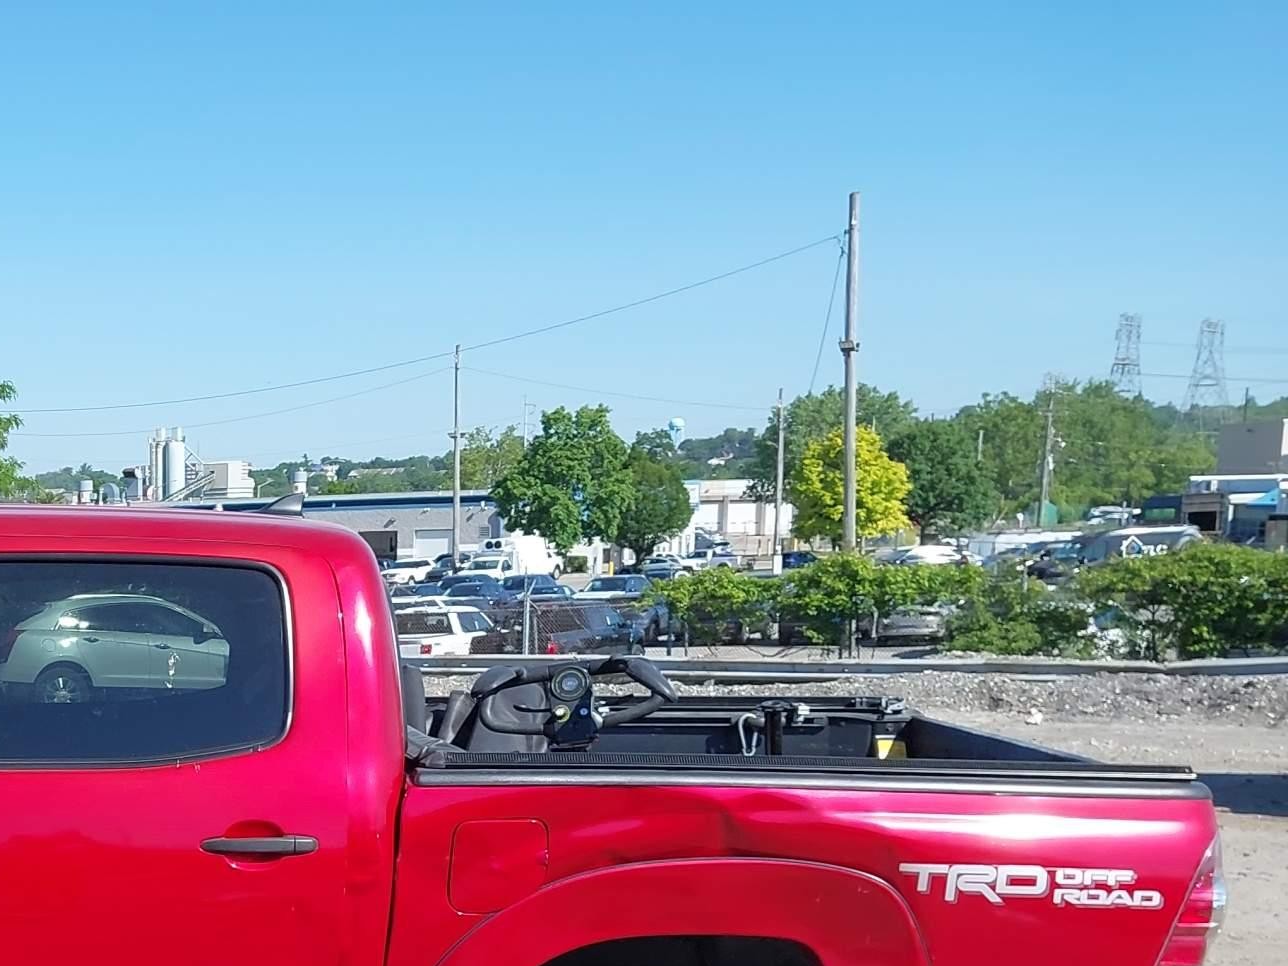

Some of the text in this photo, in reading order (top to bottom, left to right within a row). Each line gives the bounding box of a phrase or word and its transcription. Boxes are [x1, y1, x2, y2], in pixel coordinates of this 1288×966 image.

[899, 863, 1050, 906] TRD
[1054, 868, 1138, 887] OFF
[1053, 889, 1164, 909] ROAD
